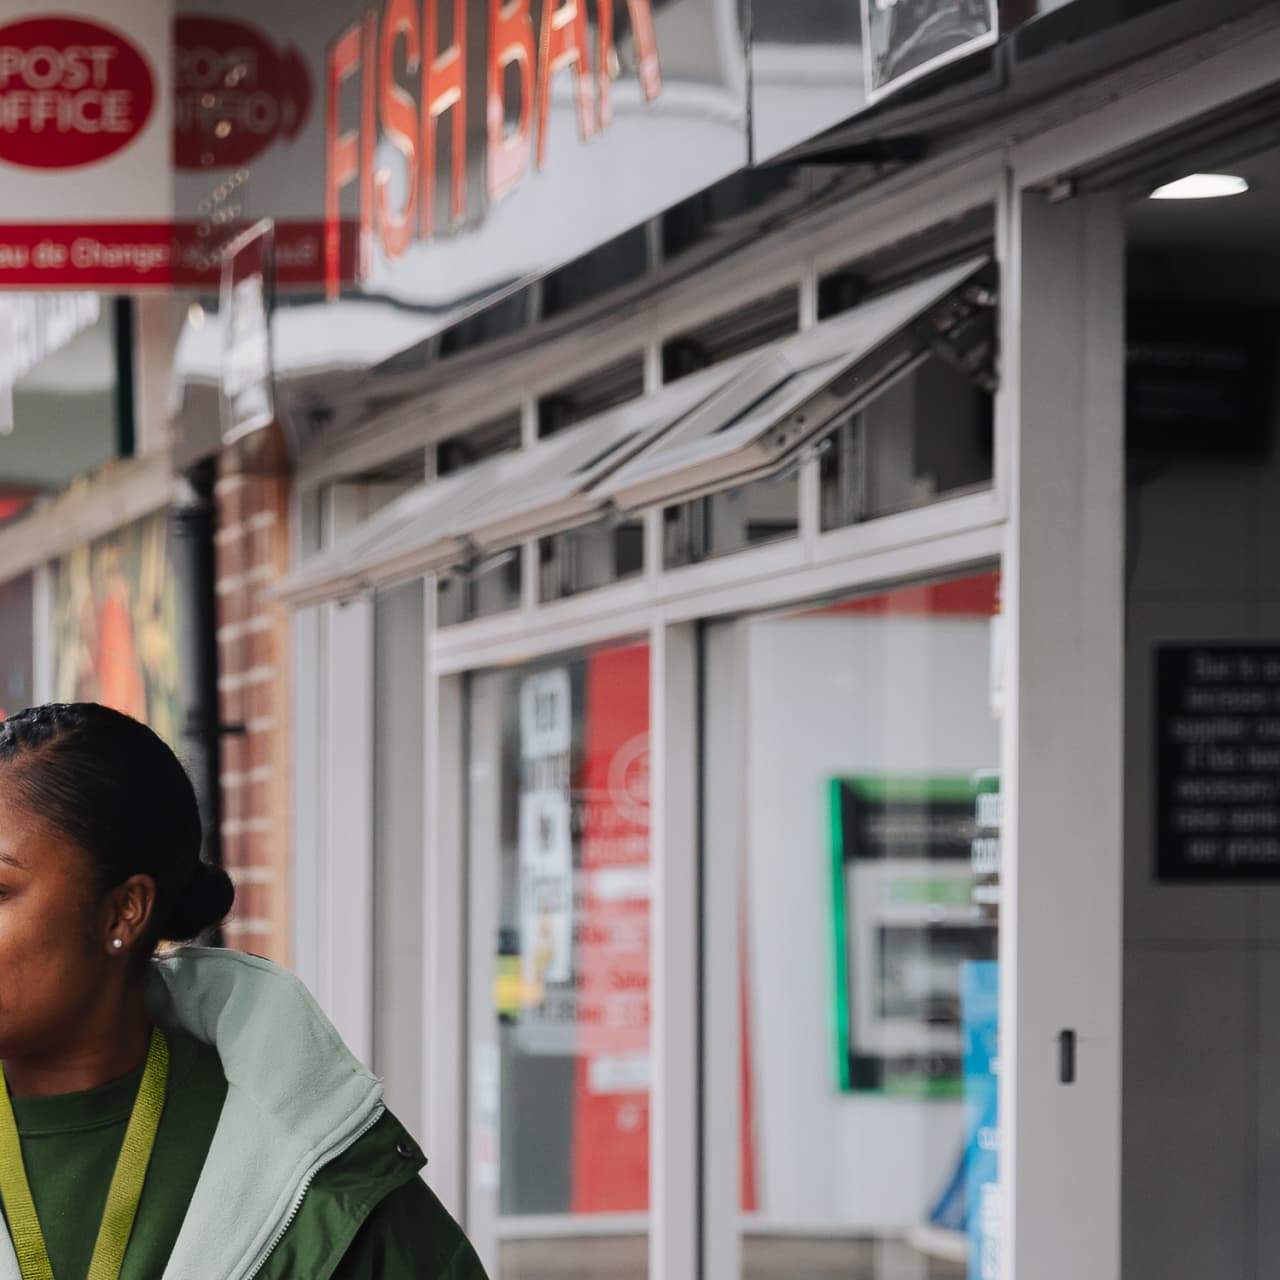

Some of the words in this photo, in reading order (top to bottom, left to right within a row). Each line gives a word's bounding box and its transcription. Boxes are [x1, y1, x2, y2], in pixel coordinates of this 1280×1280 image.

[324, 0, 468, 304] FISH
[32, 239, 69, 268] de
[70, 237, 171, 273] Change
